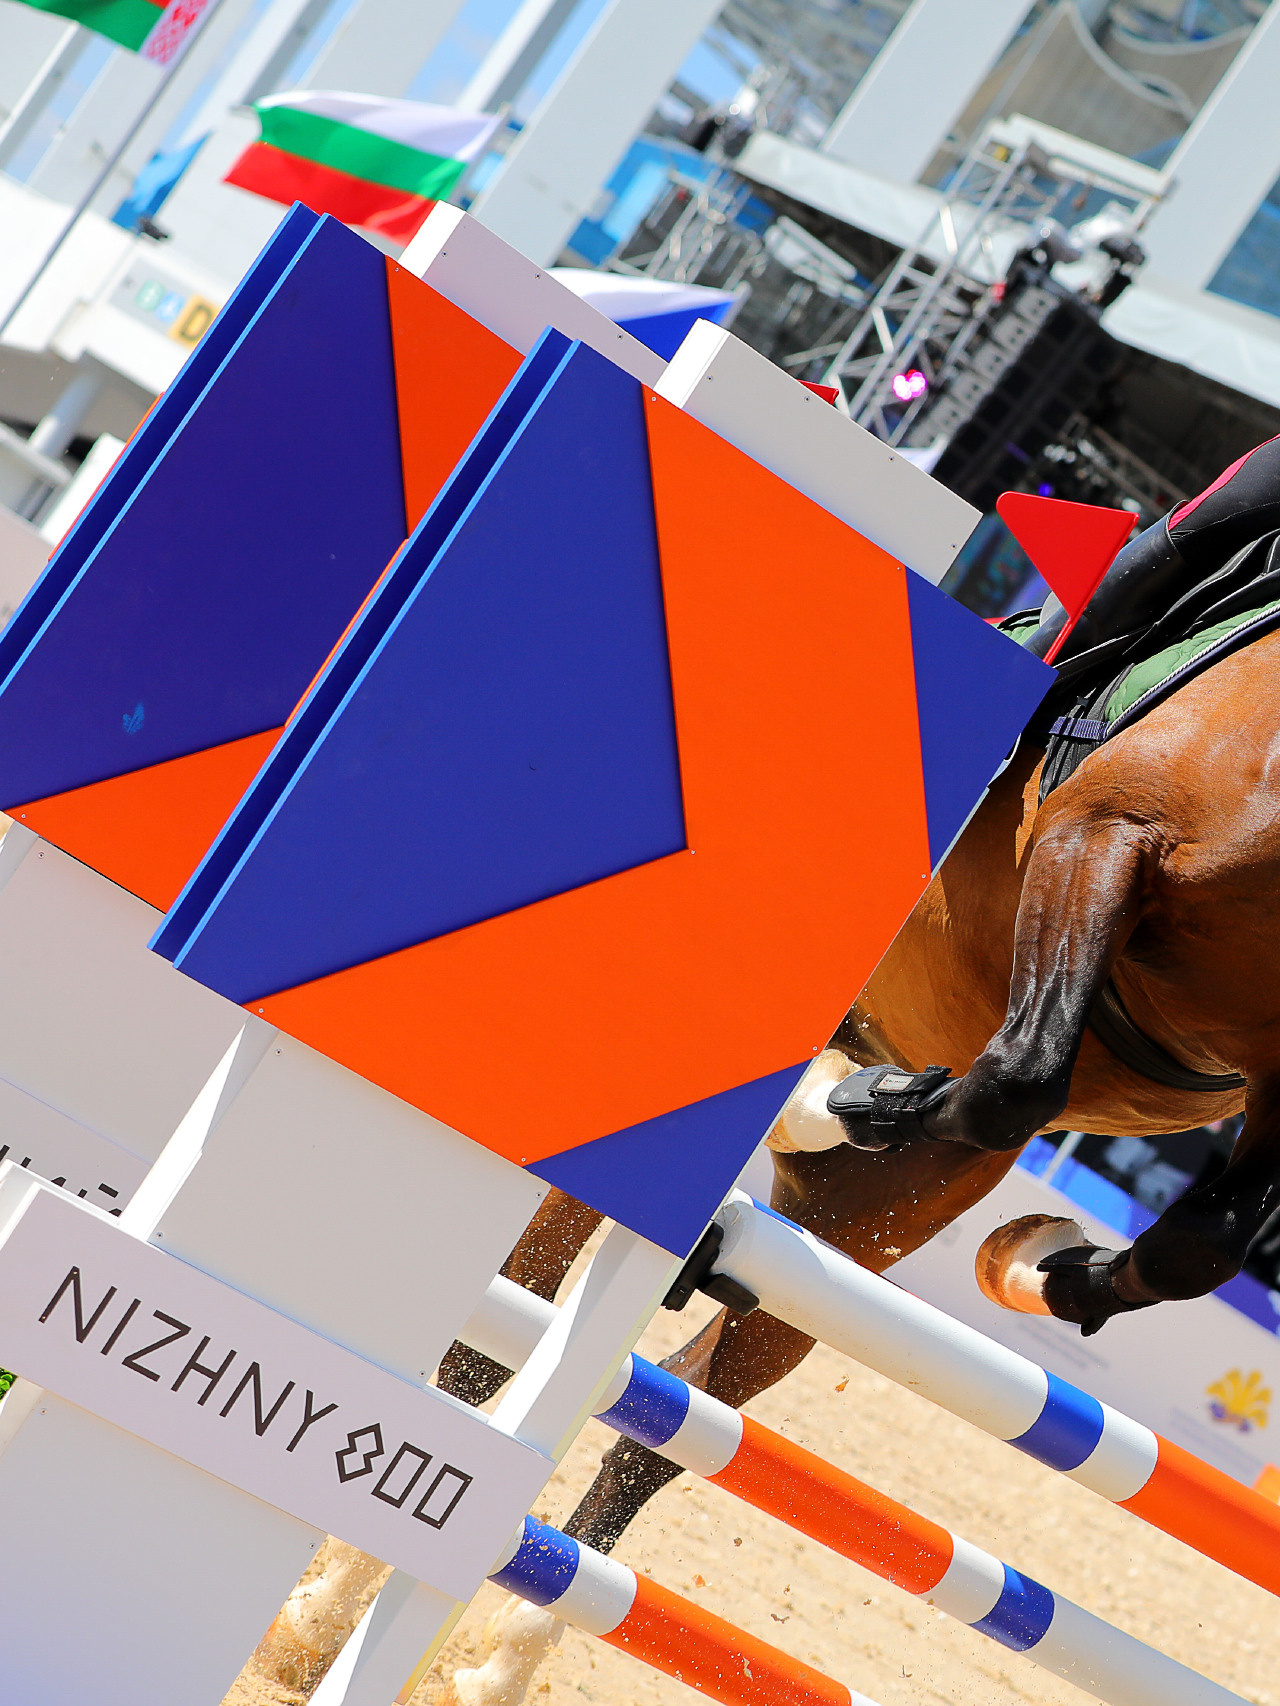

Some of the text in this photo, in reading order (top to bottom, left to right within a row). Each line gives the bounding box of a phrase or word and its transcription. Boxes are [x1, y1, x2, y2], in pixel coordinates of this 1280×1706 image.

[180, 305, 212, 341] D
[38, 1265, 474, 1530] NIZHNY 800
